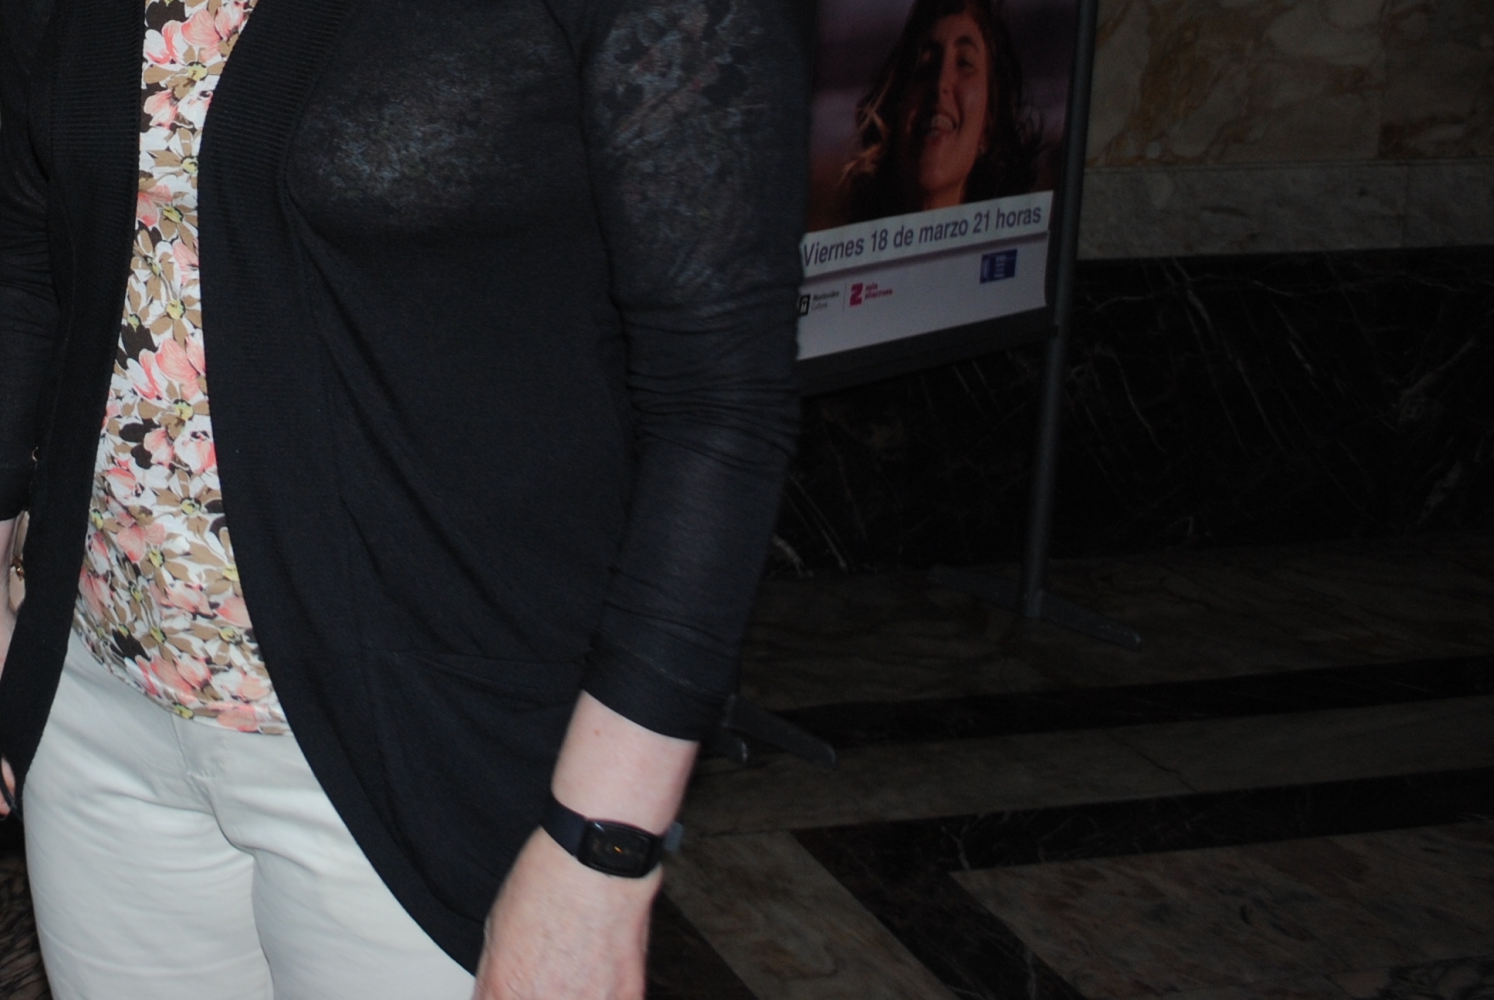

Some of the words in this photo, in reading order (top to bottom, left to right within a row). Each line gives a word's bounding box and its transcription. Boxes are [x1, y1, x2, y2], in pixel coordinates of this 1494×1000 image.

[803, 239, 864, 267] Viernes
[871, 228, 888, 251] 18
[893, 225, 913, 248] de
[918, 220, 968, 244] marzo
[973, 210, 991, 234] 21
[995, 206, 1041, 230] horas
